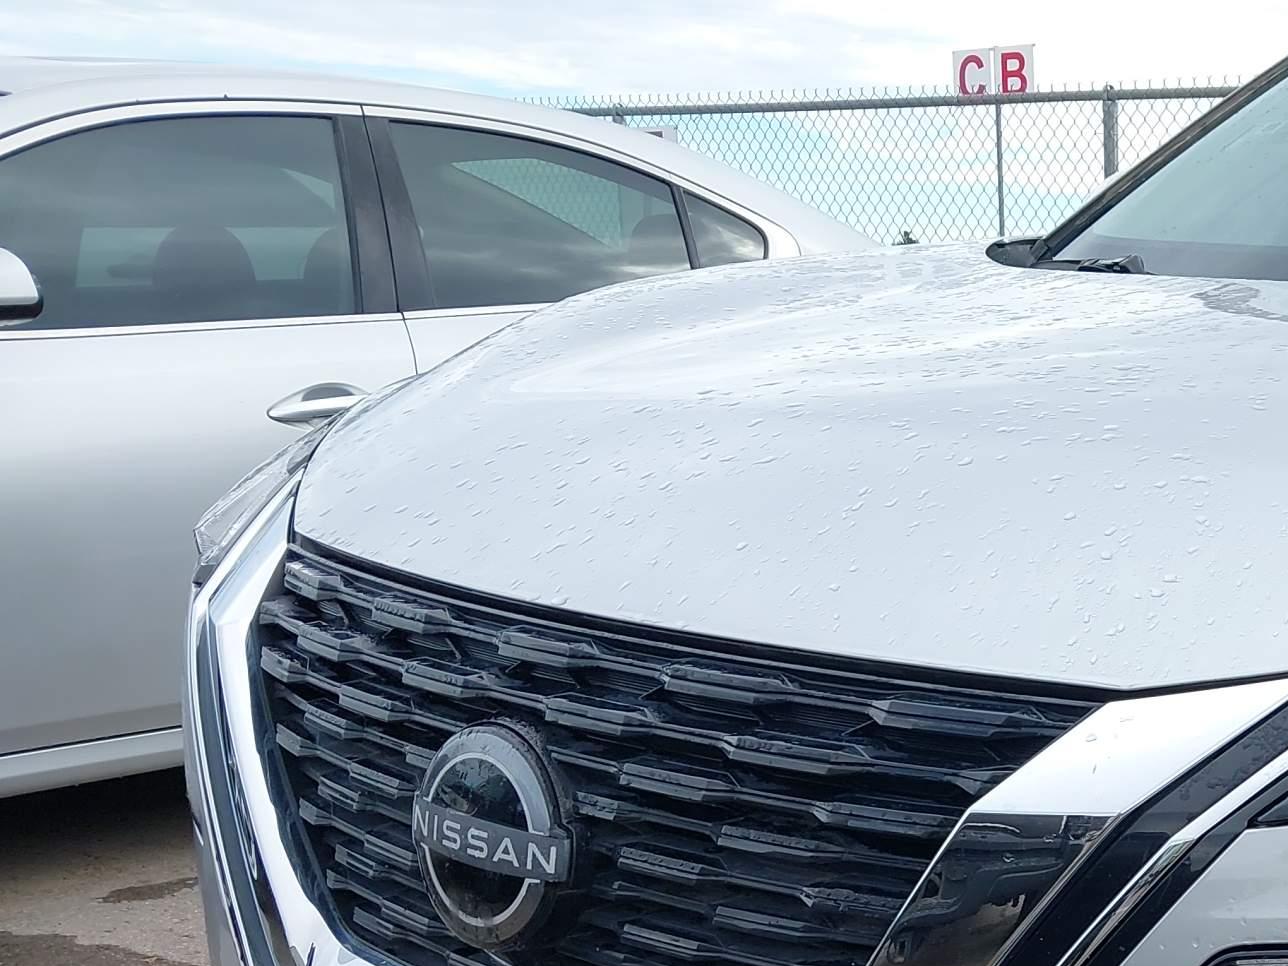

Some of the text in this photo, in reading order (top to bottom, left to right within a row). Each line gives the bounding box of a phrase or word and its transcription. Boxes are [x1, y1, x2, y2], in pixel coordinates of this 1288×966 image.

[959, 51, 1028, 96] C B
[414, 805, 557, 875] NISSAN
